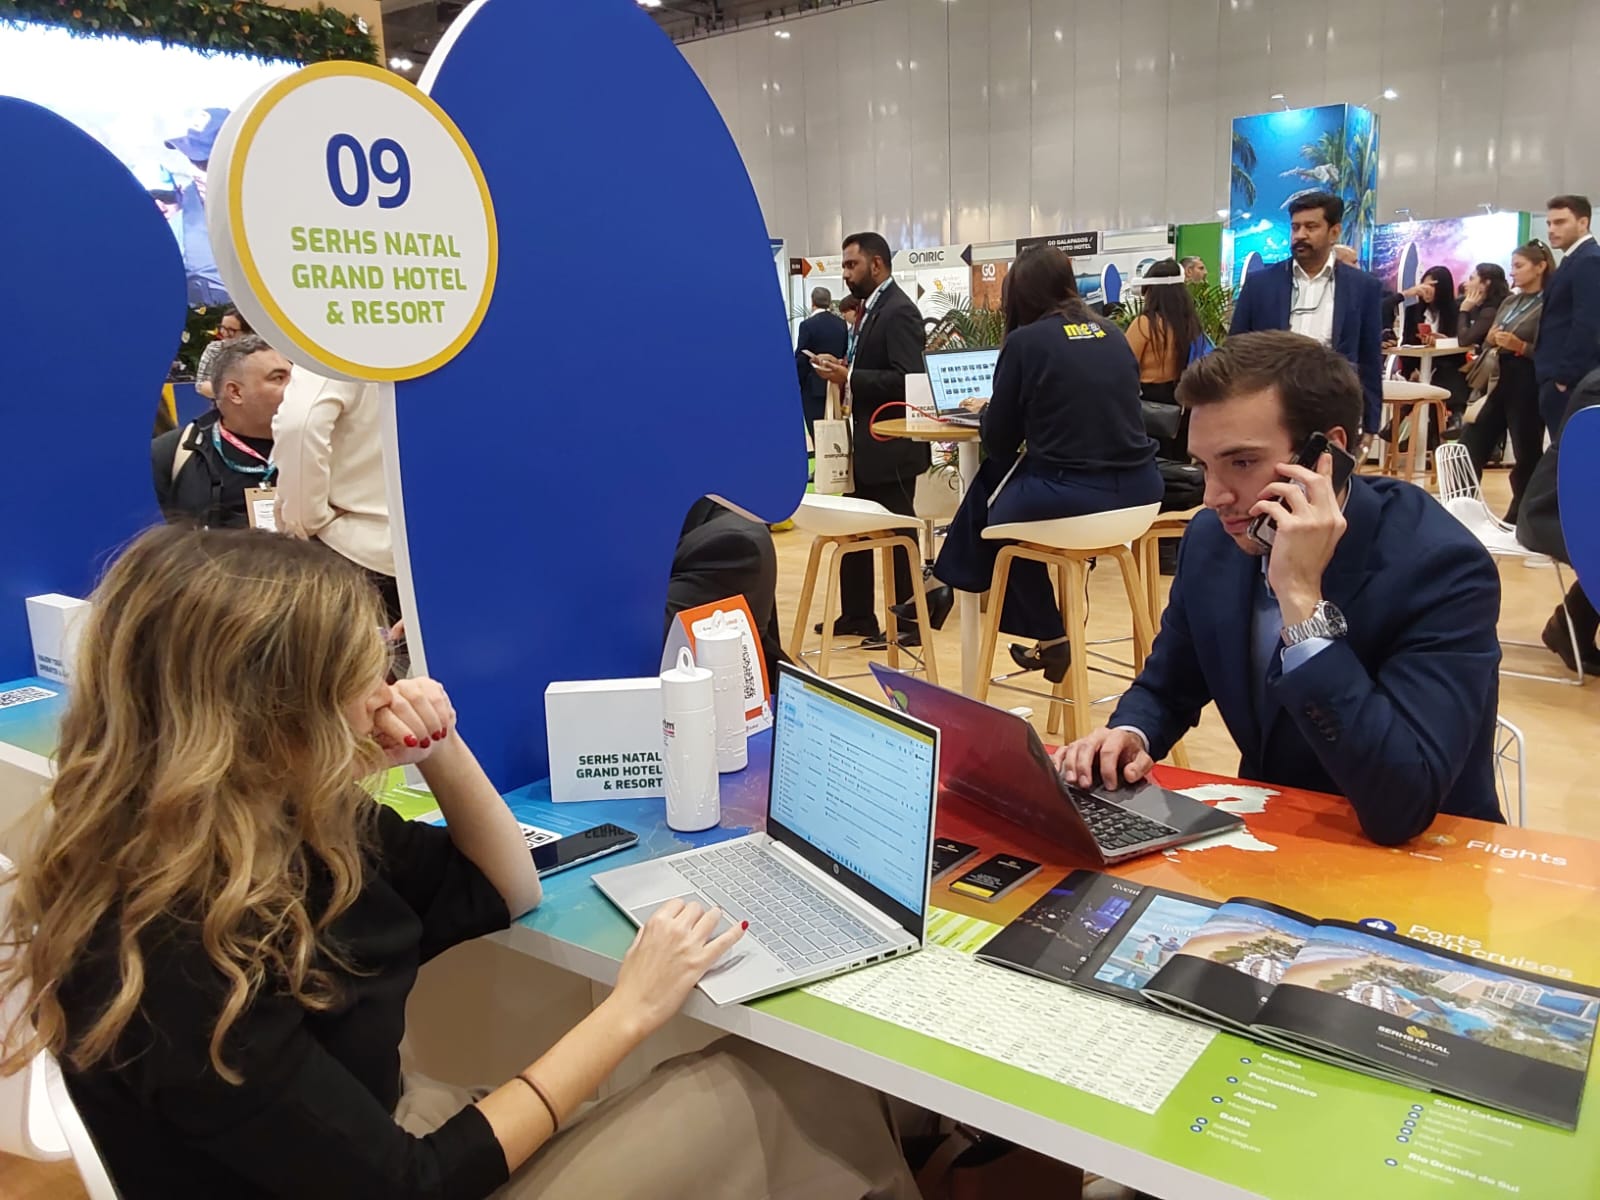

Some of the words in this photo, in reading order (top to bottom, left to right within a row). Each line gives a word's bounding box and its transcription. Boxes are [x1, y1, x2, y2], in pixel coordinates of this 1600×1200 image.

[326, 133, 411, 209] 09
[290, 226, 377, 255] SERHS
[384, 231, 461, 258] NATAL
[291, 264, 384, 289] GRAND
[393, 266, 467, 291] HOTEL
[981, 263, 996, 277] GO
[326, 301, 345, 325] &
[352, 300, 446, 325] RESORT
[578, 754, 619, 765] SERHS
[622, 752, 663, 763] NATAL
[576, 767, 619, 778] GRAND
[623, 765, 663, 776] HOTEL
[603, 780, 612, 790] &
[616, 778, 663, 789] RESORT
[1466, 840, 1568, 866] Flights
[1409, 924, 1482, 948] Ports
[1471, 949, 1573, 978] cruises
[1414, 1038, 1450, 1055] NATAL
[1433, 1099, 1469, 1114] Santa
[1408, 1152, 1429, 1164] Rio
[1429, 1159, 1477, 1179] Grande
[1497, 1180, 1520, 1193] Sul
